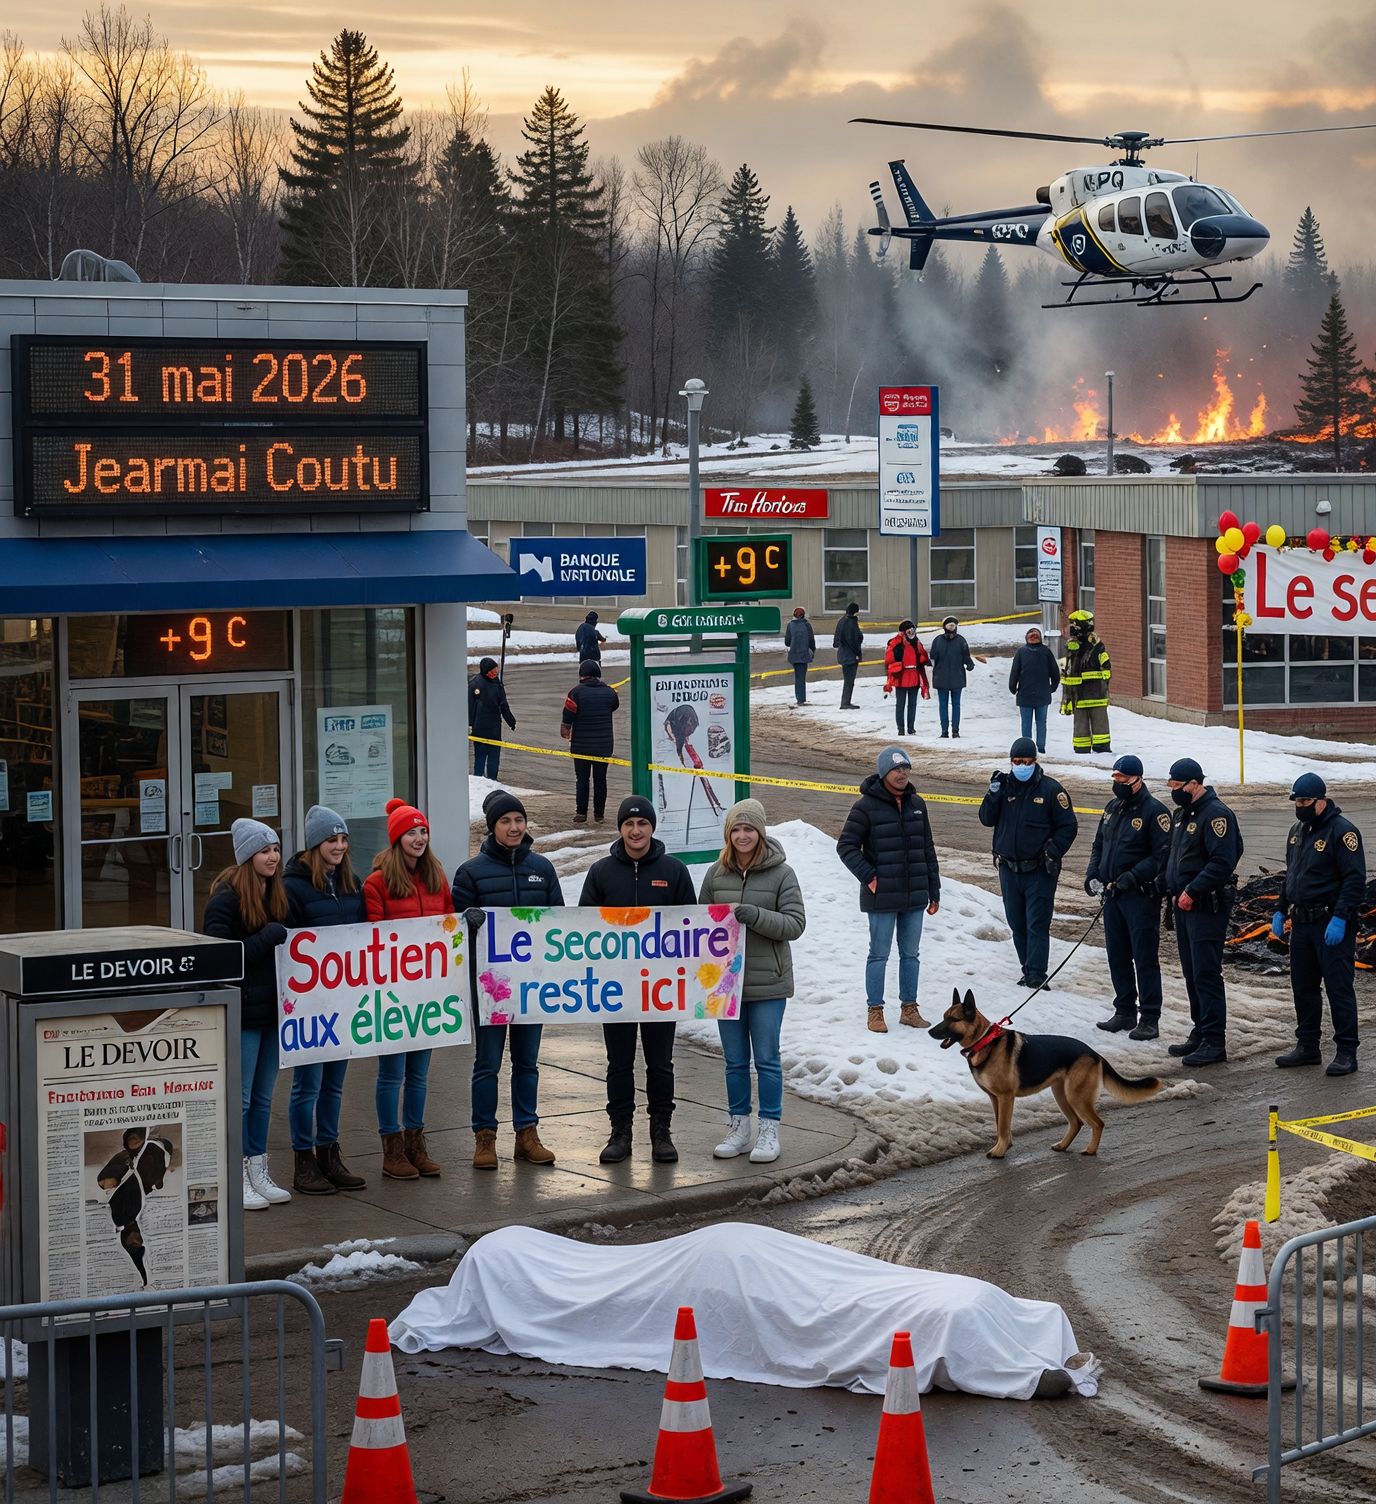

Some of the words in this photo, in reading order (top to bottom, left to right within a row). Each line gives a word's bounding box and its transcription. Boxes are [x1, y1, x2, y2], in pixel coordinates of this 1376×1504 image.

[84, 352, 139, 402] 31
[162, 354, 233, 402] mai
[252, 353, 367, 402] 2026
[64, 443, 247, 494] Jearmai
[267, 443, 397, 492] Coutu
[1256, 551, 1315, 620] Le
[287, 926, 449, 994] Soutien
[487, 911, 532, 964] Le
[544, 911, 730, 962] secondaire
[71, 963, 95, 981] LE
[100, 958, 174, 979] DEVOIR
[519, 967, 624, 1015] reste
[639, 967, 686, 1013] ici
[280, 1011, 340, 1052] aux
[350, 989, 464, 1046] élèves
[64, 1045, 95, 1069] LE
[102, 1037, 200, 1066] DEVOIR
